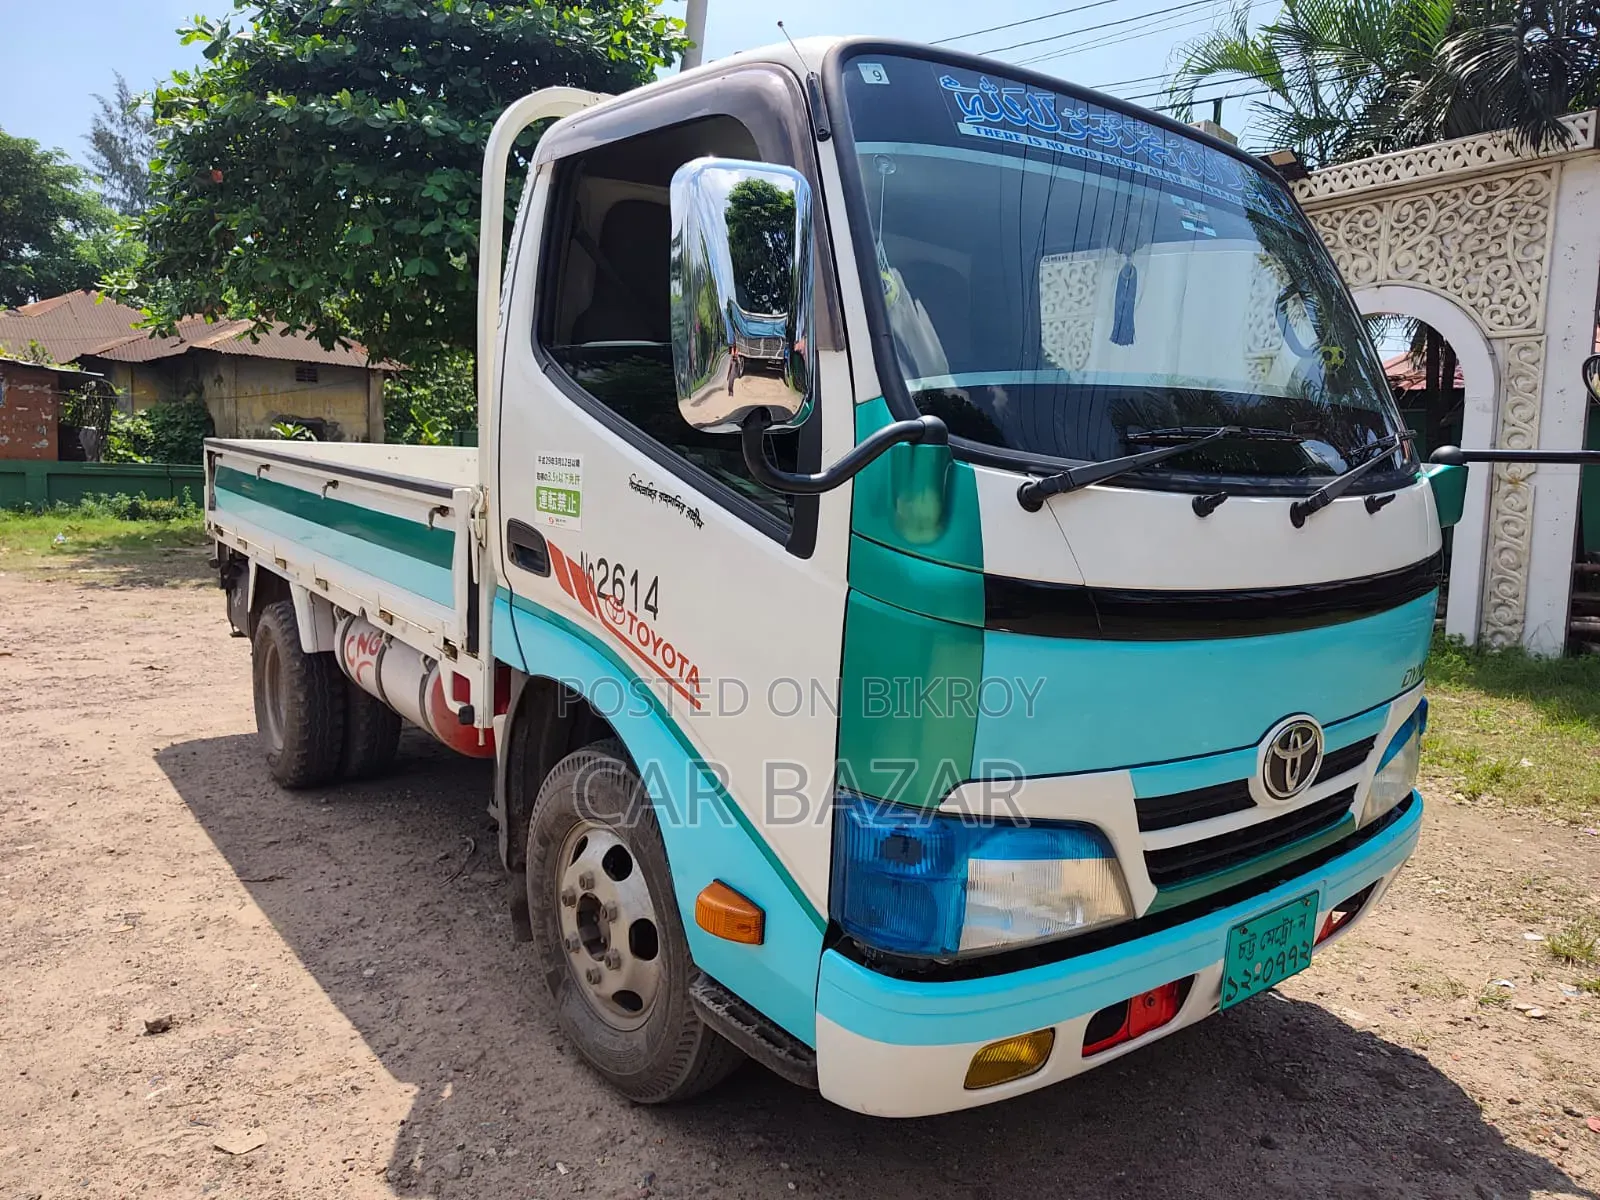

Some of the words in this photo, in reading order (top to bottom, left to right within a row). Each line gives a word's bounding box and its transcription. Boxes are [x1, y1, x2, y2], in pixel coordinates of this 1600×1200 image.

[973, 126, 1023, 142] THERE
[1027, 136, 1042, 146] IS
[1046, 140, 1065, 151] NO
[1069, 146, 1097, 158] GOD
[1100, 153, 1145, 172] EXCEPT
[538, 489, 577, 514] 運転禁止
[597, 557, 659, 621] 2614
[346, 630, 383, 667] CNG
[627, 610, 701, 694] TOYOTA
